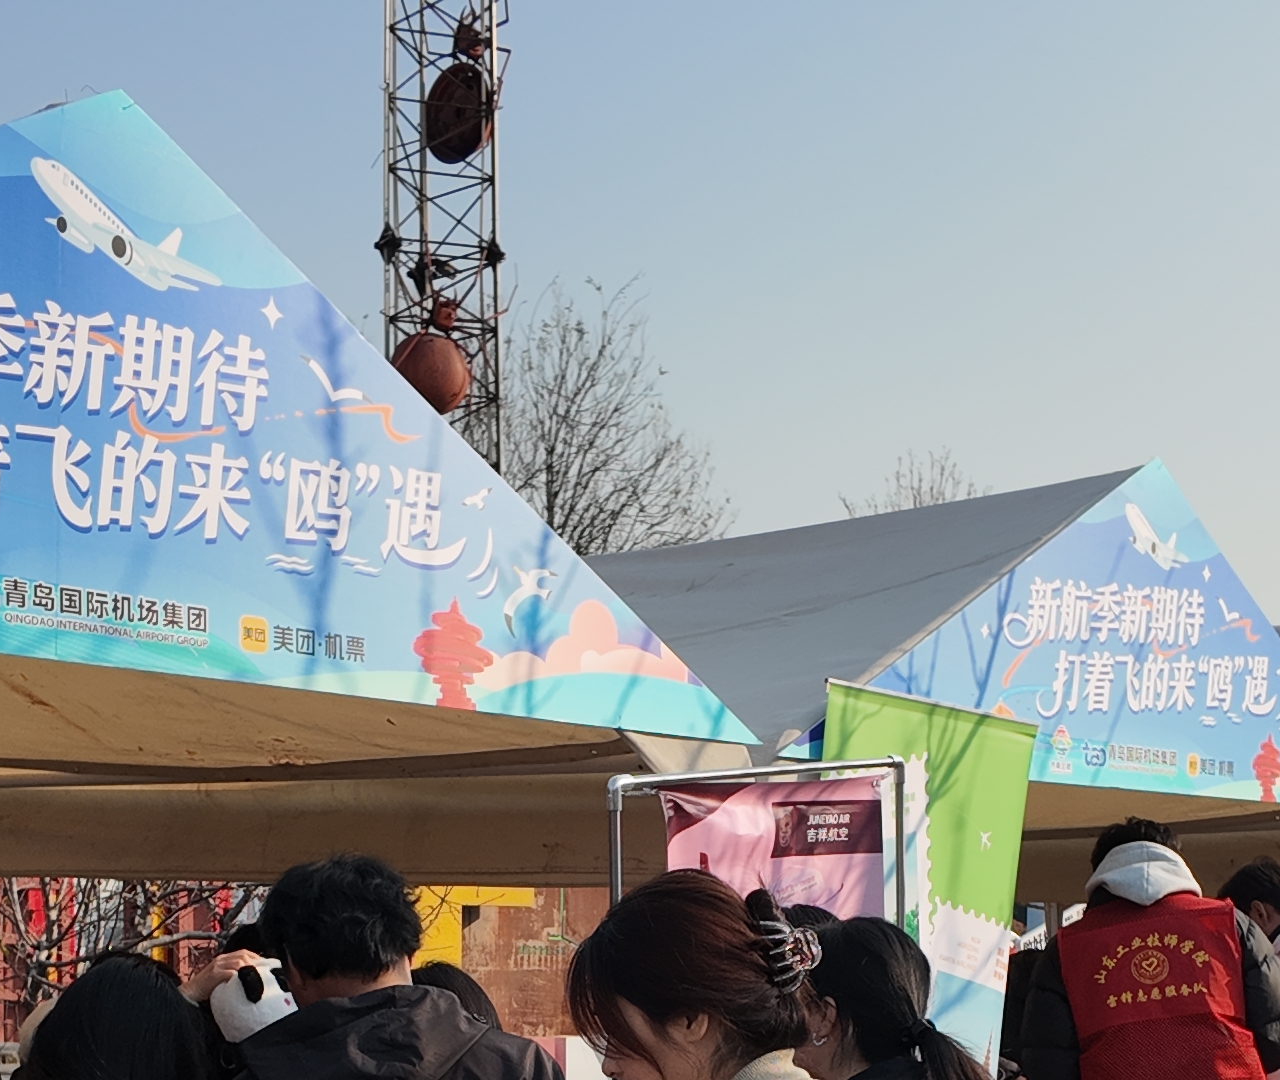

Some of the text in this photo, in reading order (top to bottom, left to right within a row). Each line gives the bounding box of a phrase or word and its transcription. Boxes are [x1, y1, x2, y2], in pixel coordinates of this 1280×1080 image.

[3, 578, 208, 633] 青岛国际机场集团
[1003, 576, 1205, 648] 新航季新期待
[4, 613, 209, 648] QINGDAO INTERNATIONAL AIRPORT GROUP
[243, 626, 266, 643] 美团
[273, 624, 366, 662] 美团·机票
[807, 827, 849, 843] 吉祥航空
[839, 813, 851, 824] AIR
[1094, 932, 1210, 984] 山东工业技师学院
